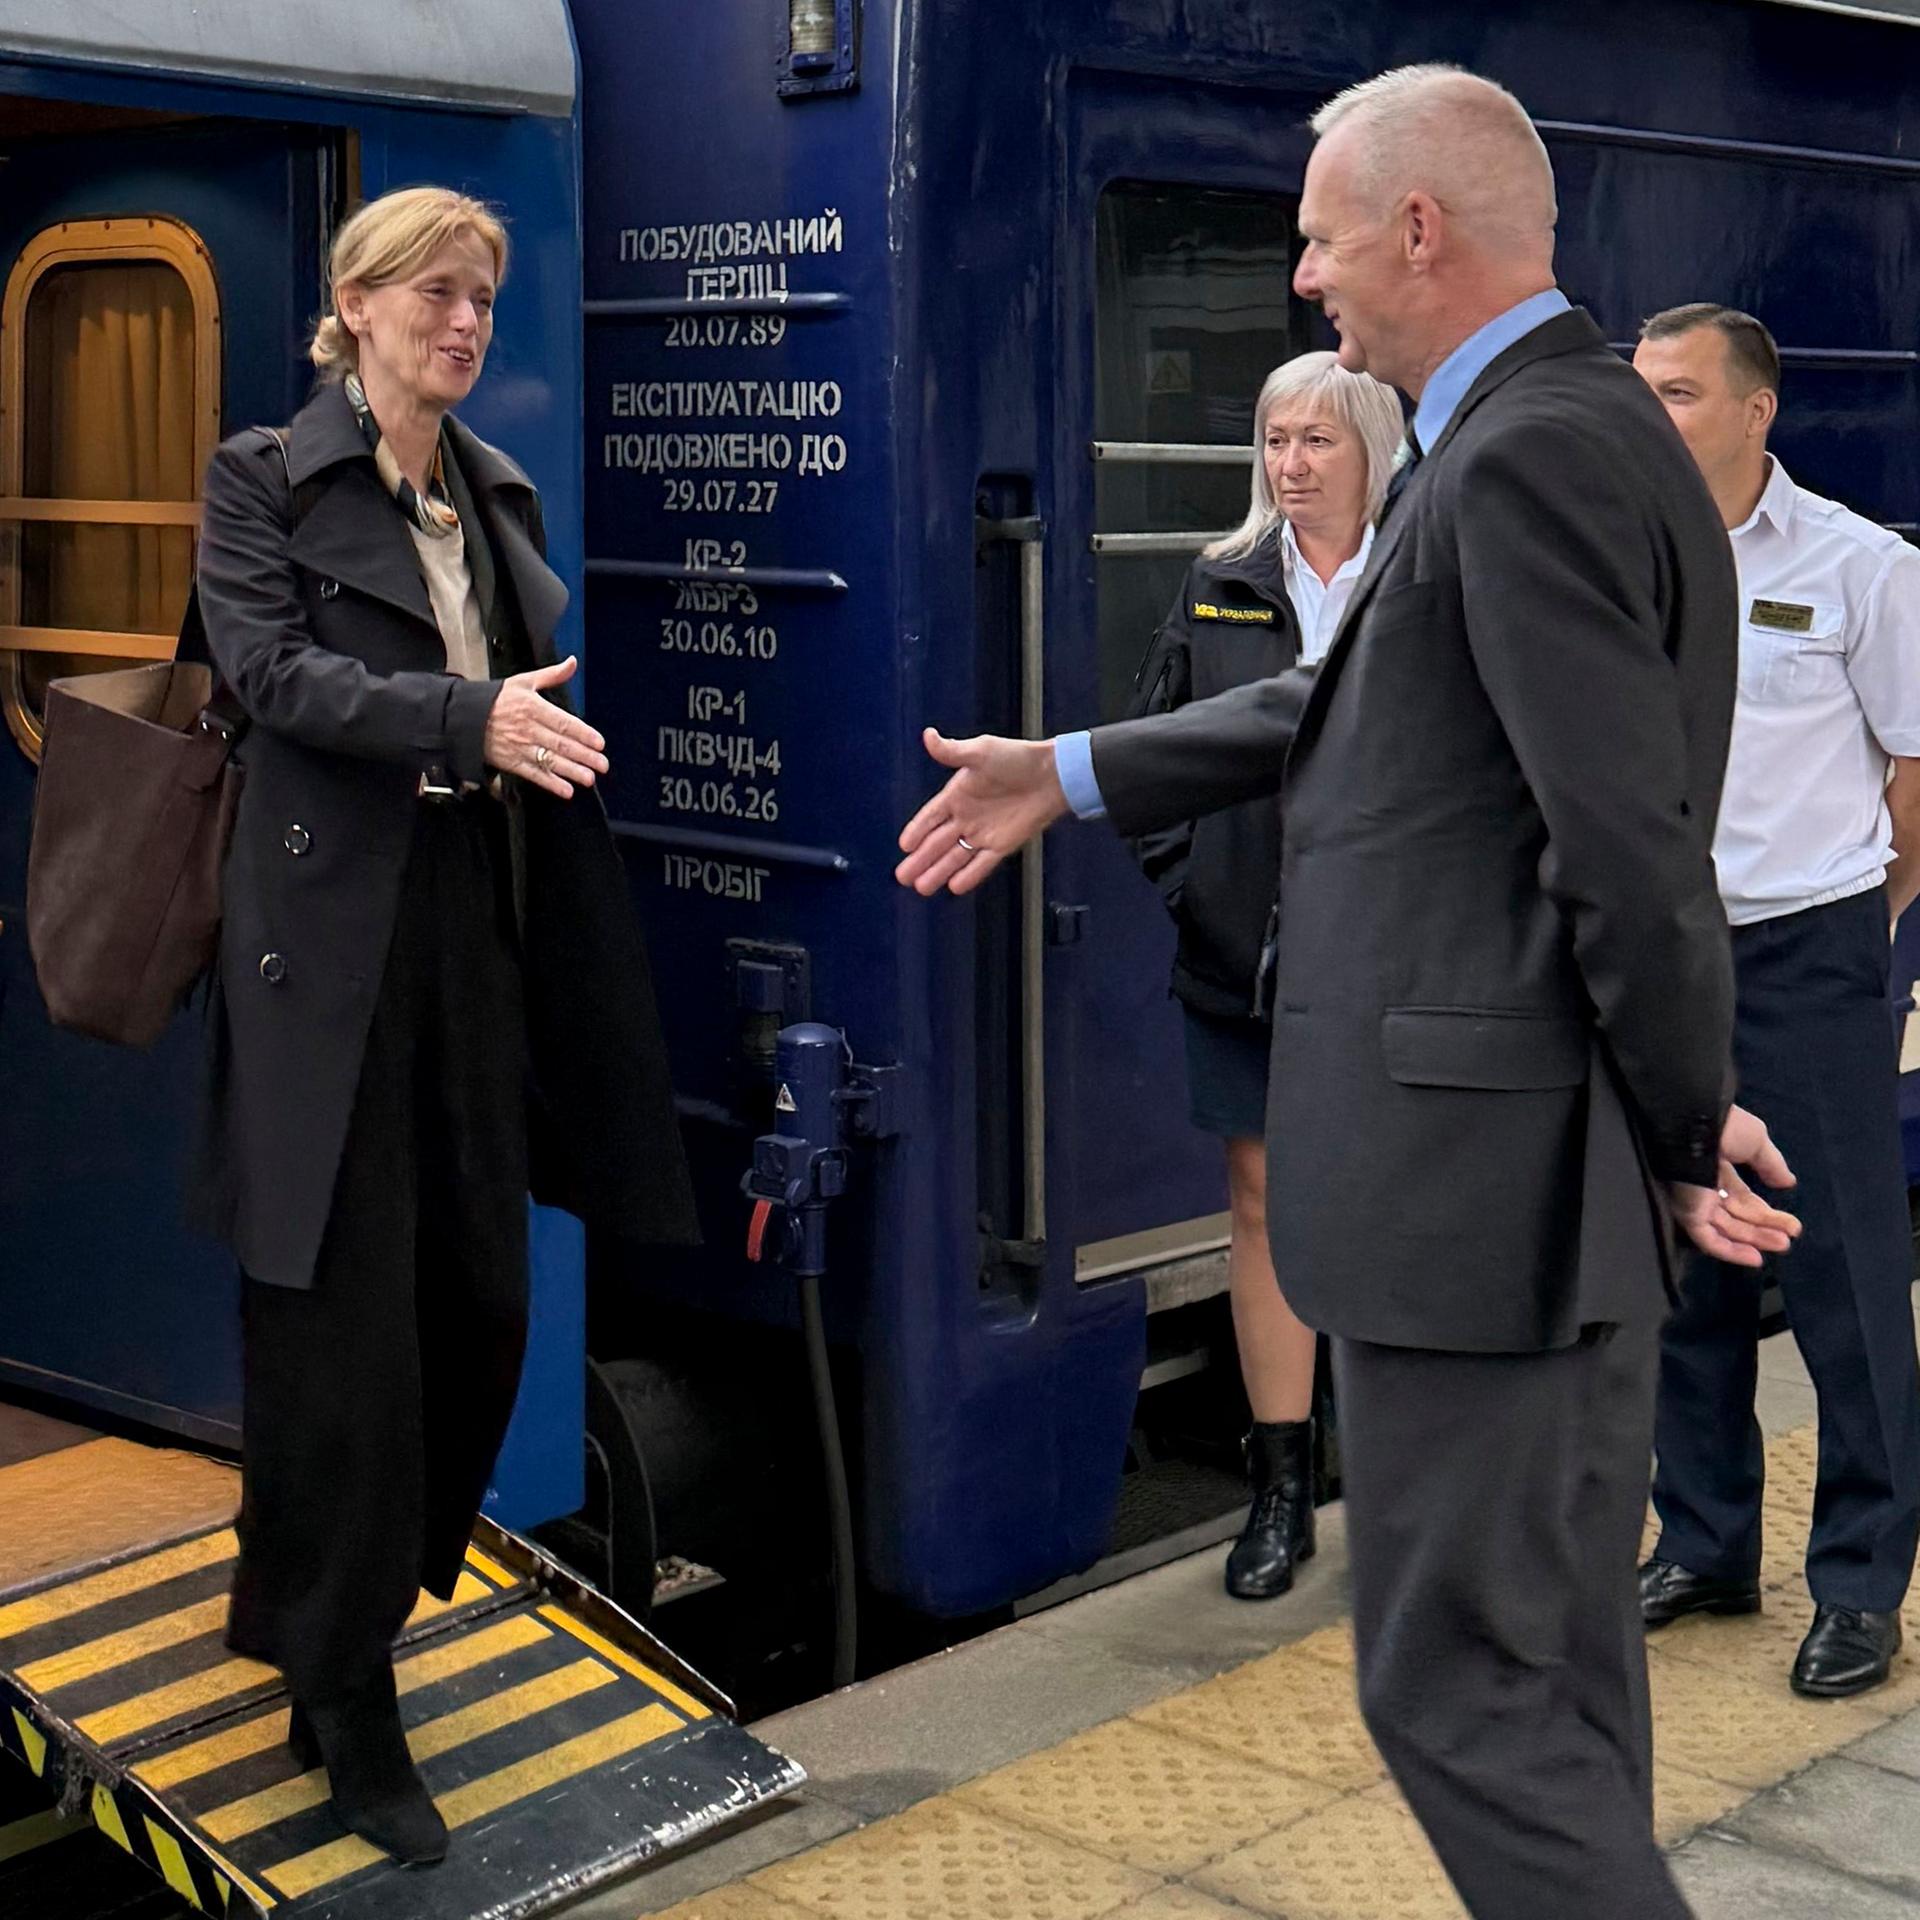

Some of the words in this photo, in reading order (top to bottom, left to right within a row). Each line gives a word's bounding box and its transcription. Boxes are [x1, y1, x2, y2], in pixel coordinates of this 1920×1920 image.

[620, 208, 841, 263] ПОБУДОВАНИЙ
[686, 263, 789, 303] ГЕРЛІЦ
[665, 315, 786, 346] 20.07.89
[612, 381, 841, 420] ЕКСПЛУАТАЦІЮ
[604, 434, 791, 474] ПОДОВЖЕНО
[799, 434, 847, 476] ДО
[662, 480, 778, 512] 29.07.27
[684, 539, 747, 572] КР-2
[660, 619, 777, 659] 30.06.10
[688, 685, 746, 725] КР-1
[658, 726, 781, 778] ПКВЧД-4
[659, 777, 778, 822] 30.06.26
[664, 854, 770, 902] ПРОБІГ
